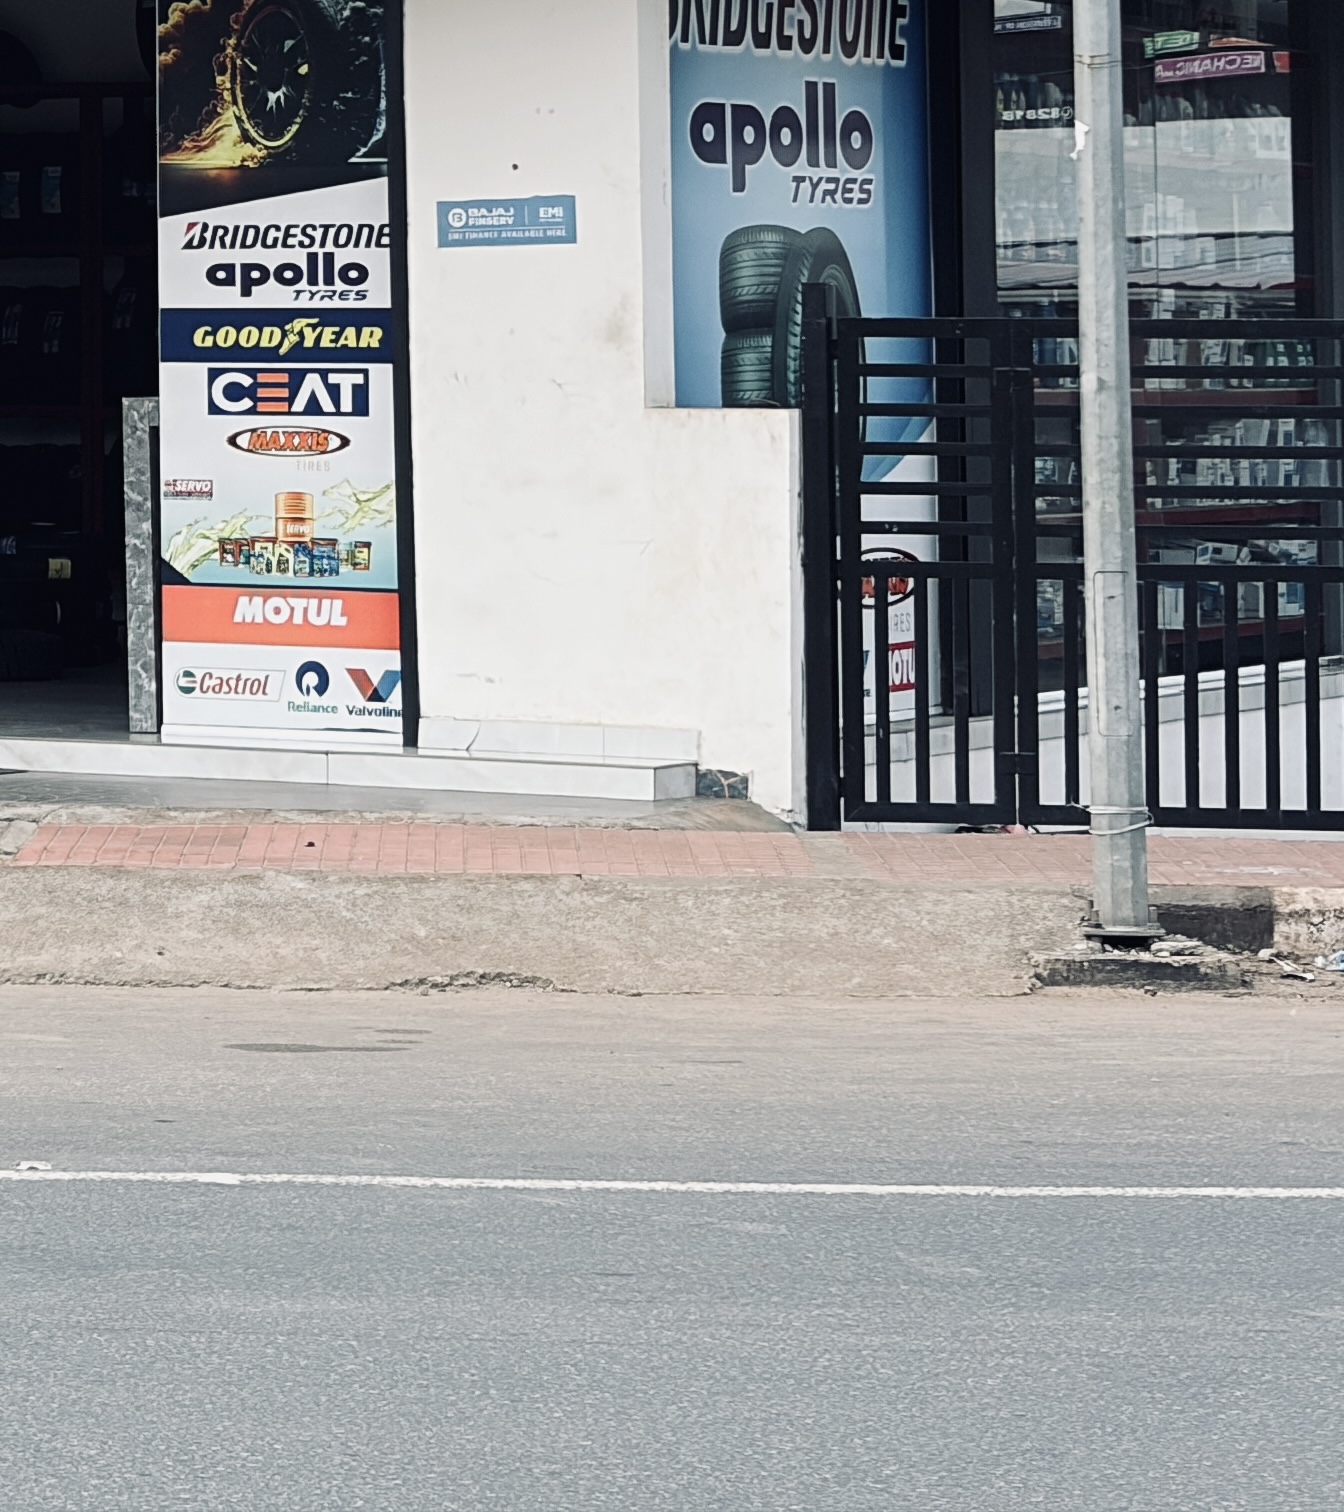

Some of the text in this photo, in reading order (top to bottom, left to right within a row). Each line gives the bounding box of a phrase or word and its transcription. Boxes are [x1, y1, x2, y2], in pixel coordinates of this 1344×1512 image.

[689, 79, 873, 193] apollo
[791, 175, 874, 205] TYRES
[468, 207, 563, 218] BAJAJ EMI
[468, 216, 514, 226] FINSERV
[205, 252, 369, 297] apollo
[293, 290, 369, 301] TYRES
[212, 372, 364, 413] CEAT
[247, 429, 330, 453] MAXXIS
[296, 460, 331, 472] TIRES
[175, 480, 212, 493] SERVO
[233, 597, 348, 627] MOTUL
[199, 671, 269, 697] Castrol
[288, 701, 338, 714] Reliance
